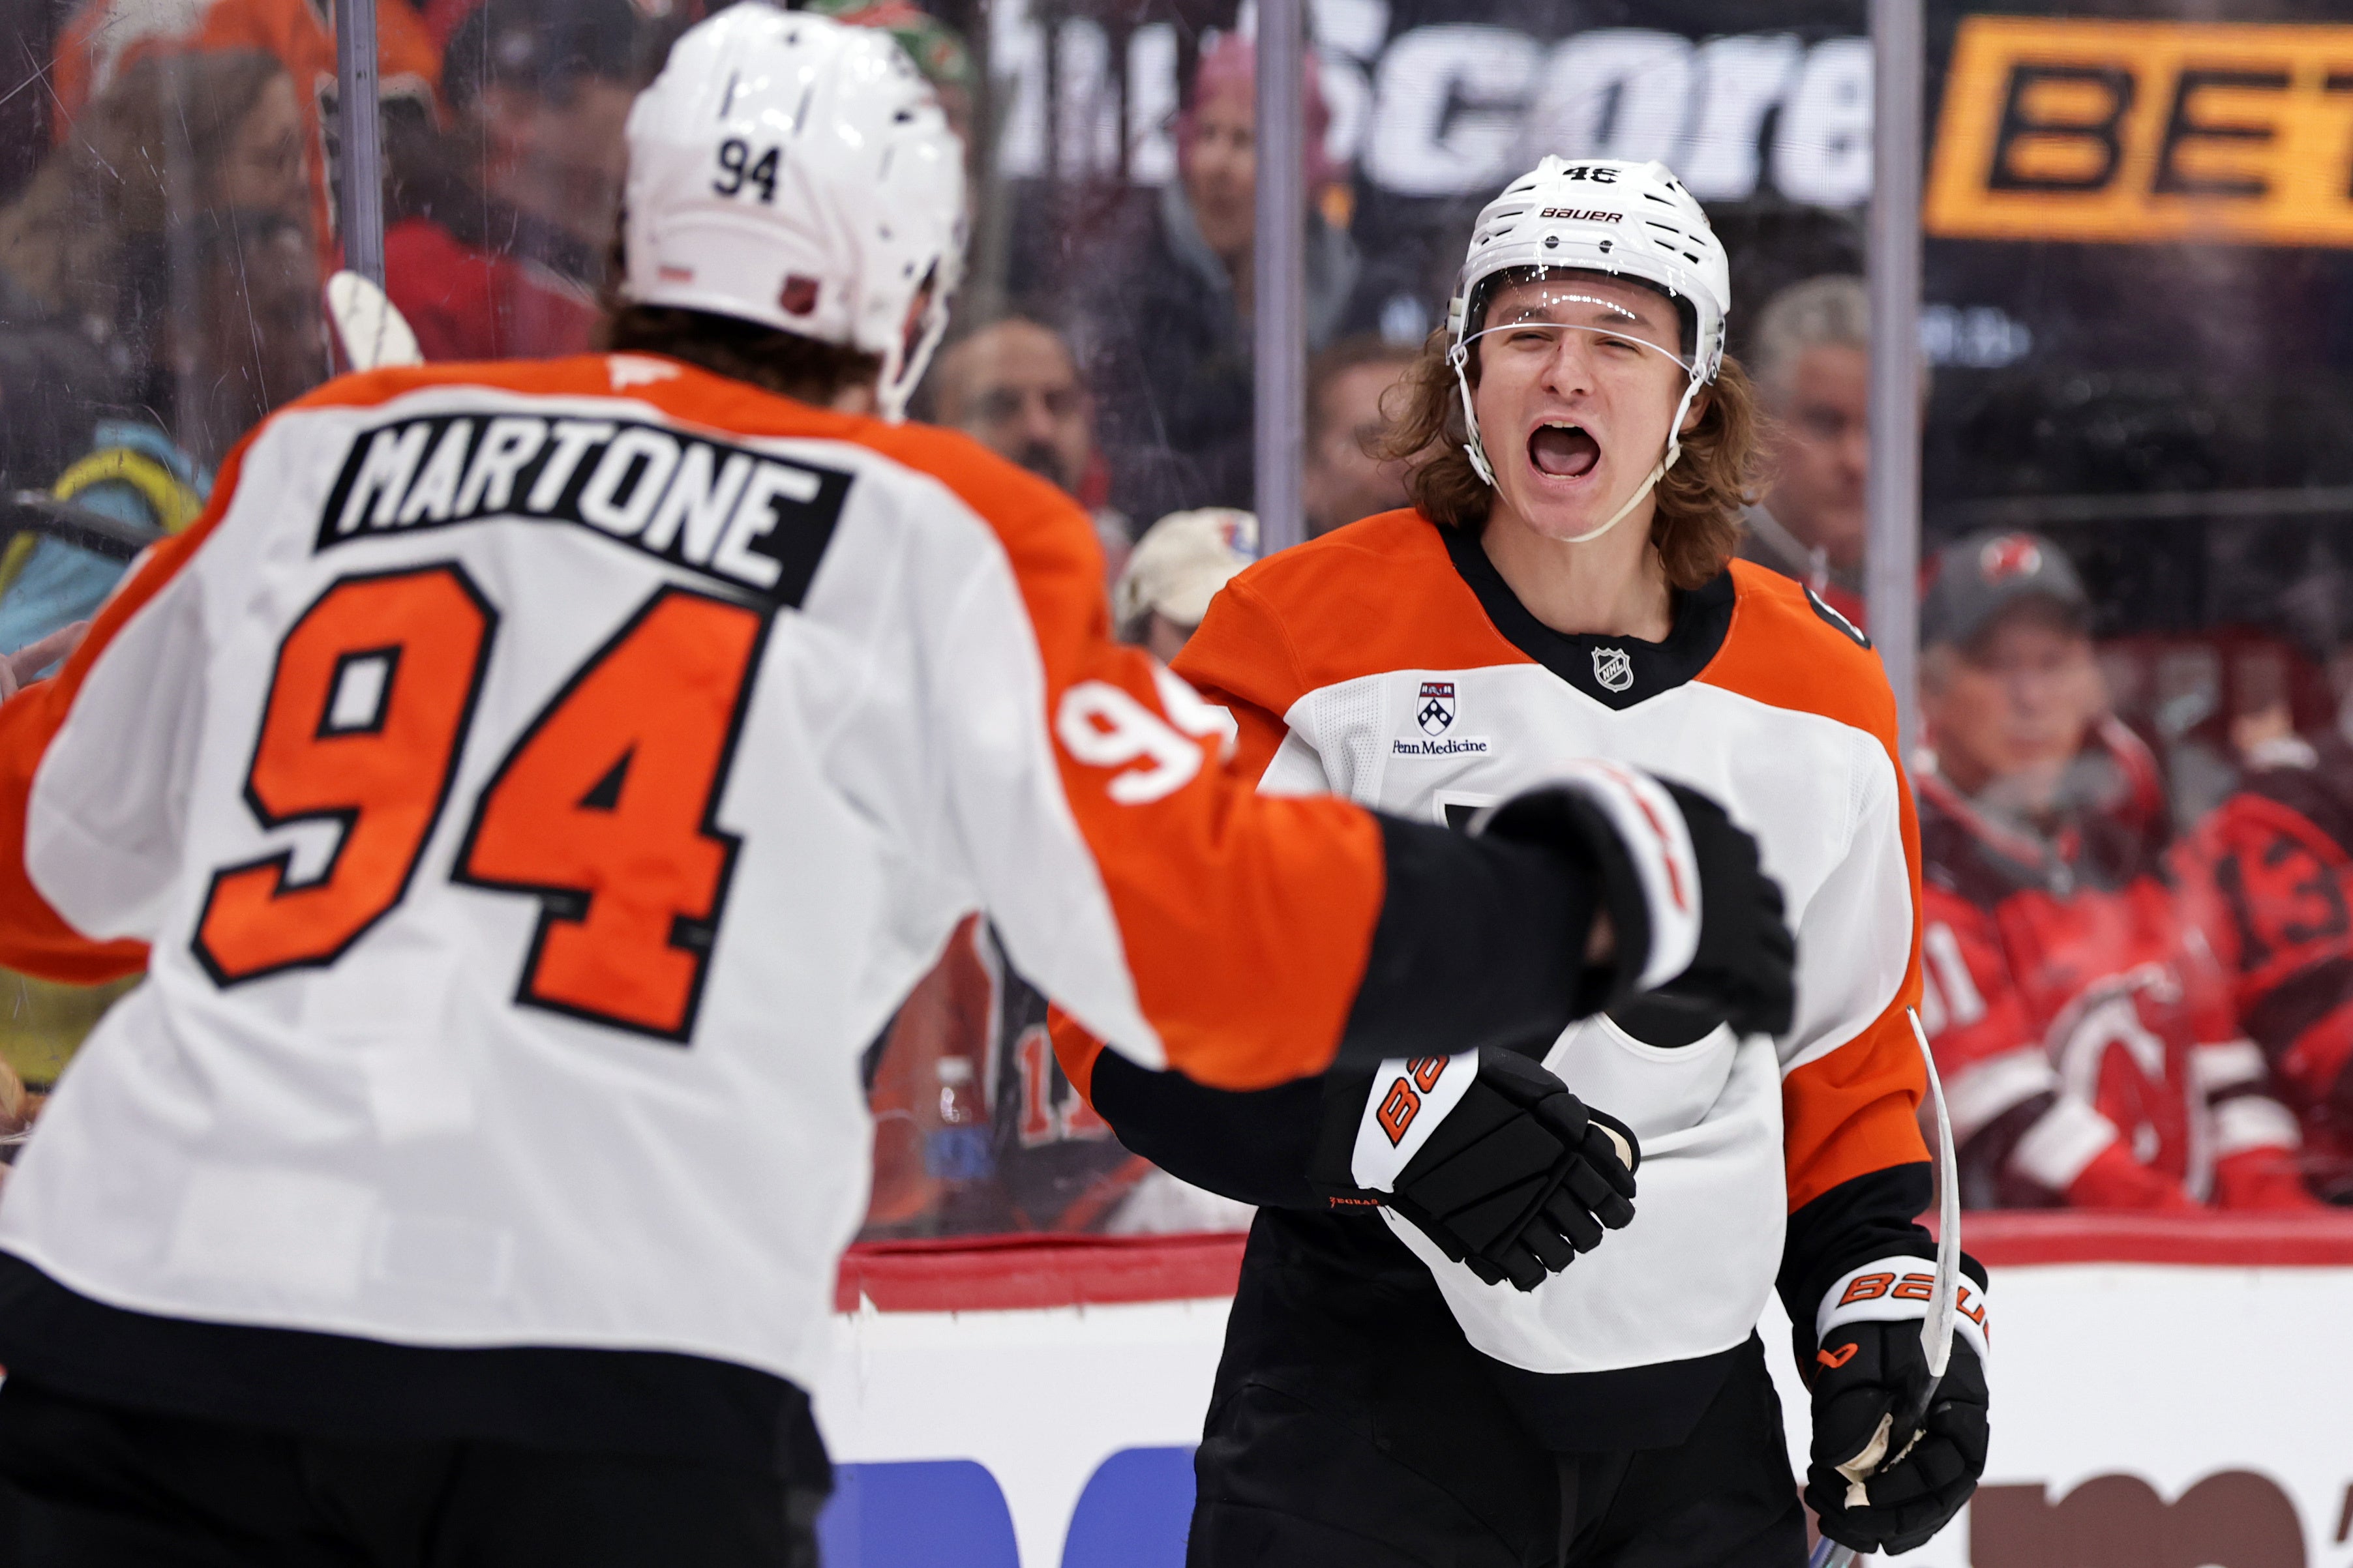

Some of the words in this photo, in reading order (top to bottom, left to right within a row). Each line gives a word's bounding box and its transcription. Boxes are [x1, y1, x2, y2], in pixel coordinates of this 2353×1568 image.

[1988, 64, 2353, 196] BE
[713, 138, 779, 201] 94
[1540, 207, 1623, 224] BAUER
[336, 416, 822, 588] MARTONE
[1602, 660, 1623, 681] NHL
[1392, 739, 1420, 754] Penn
[1422, 739, 1487, 755] Medicine
[189, 559, 743, 1044] 94
